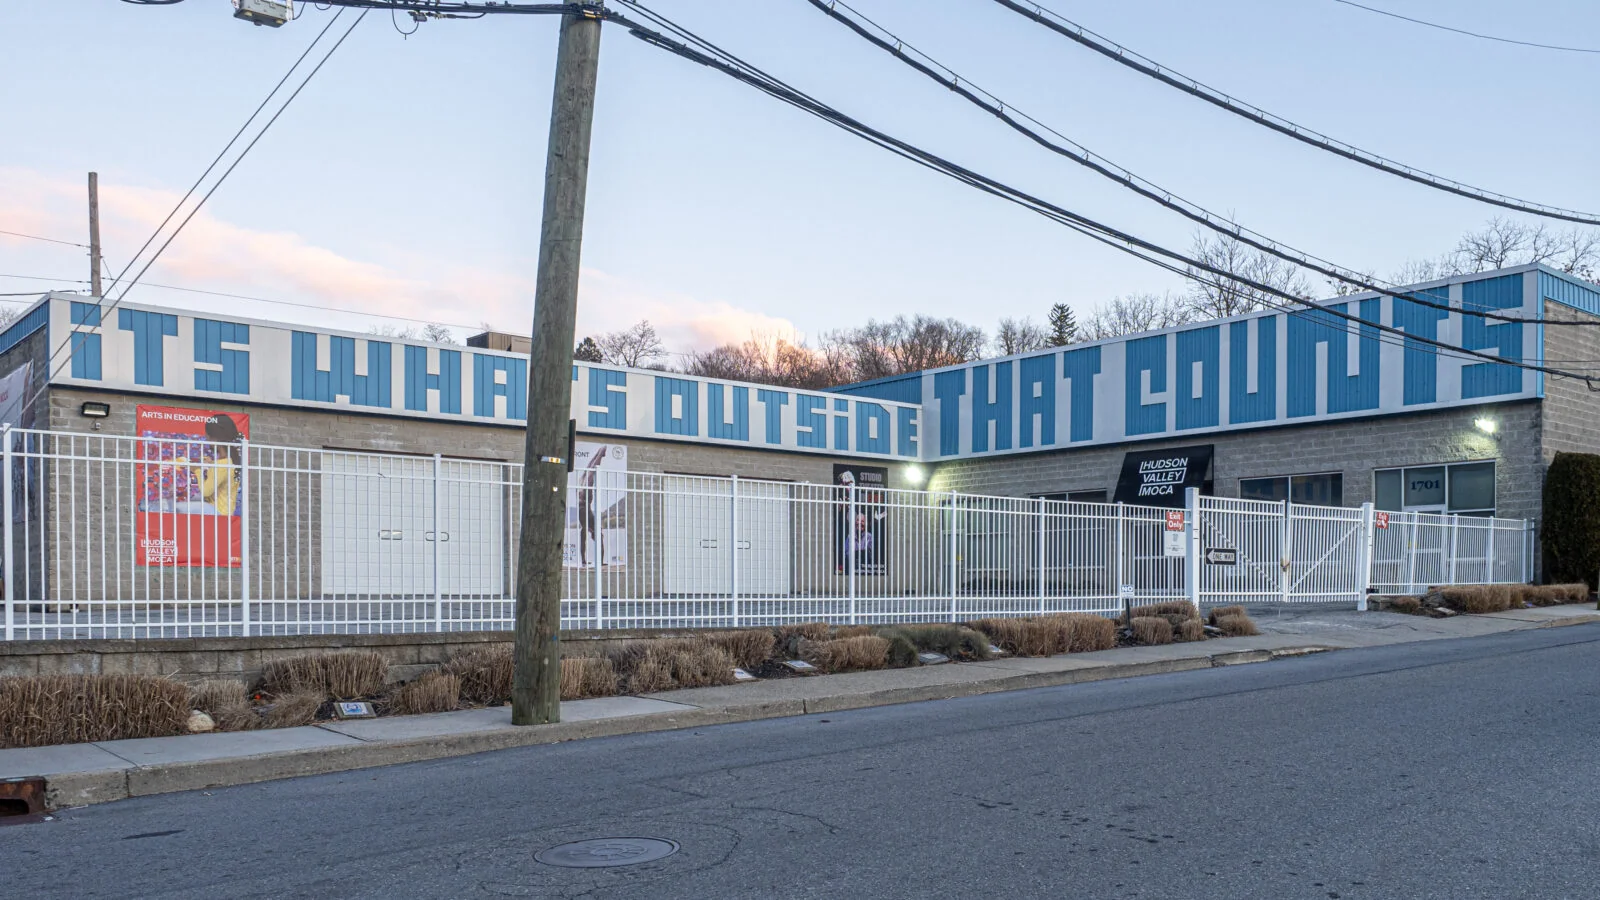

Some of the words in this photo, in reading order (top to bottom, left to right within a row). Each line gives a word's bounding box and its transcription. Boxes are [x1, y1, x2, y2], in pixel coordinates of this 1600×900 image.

[934, 345, 1101, 456] THAT
[1125, 273, 1523, 436] COUNTS
[291, 330, 627, 430] WHAS
[142, 411, 162, 419] ARTS
[174, 414, 218, 424] EDUCATION
[1143, 457, 1189, 470] HUDSON
[860, 472, 882, 482] STUDIO
[1143, 471, 1182, 483] VALLEY
[1142, 485, 1173, 496] MOCA
[1411, 480, 1440, 492] 1701
[1169, 512, 1181, 520] Exit
[1168, 520, 1183, 530] Only
